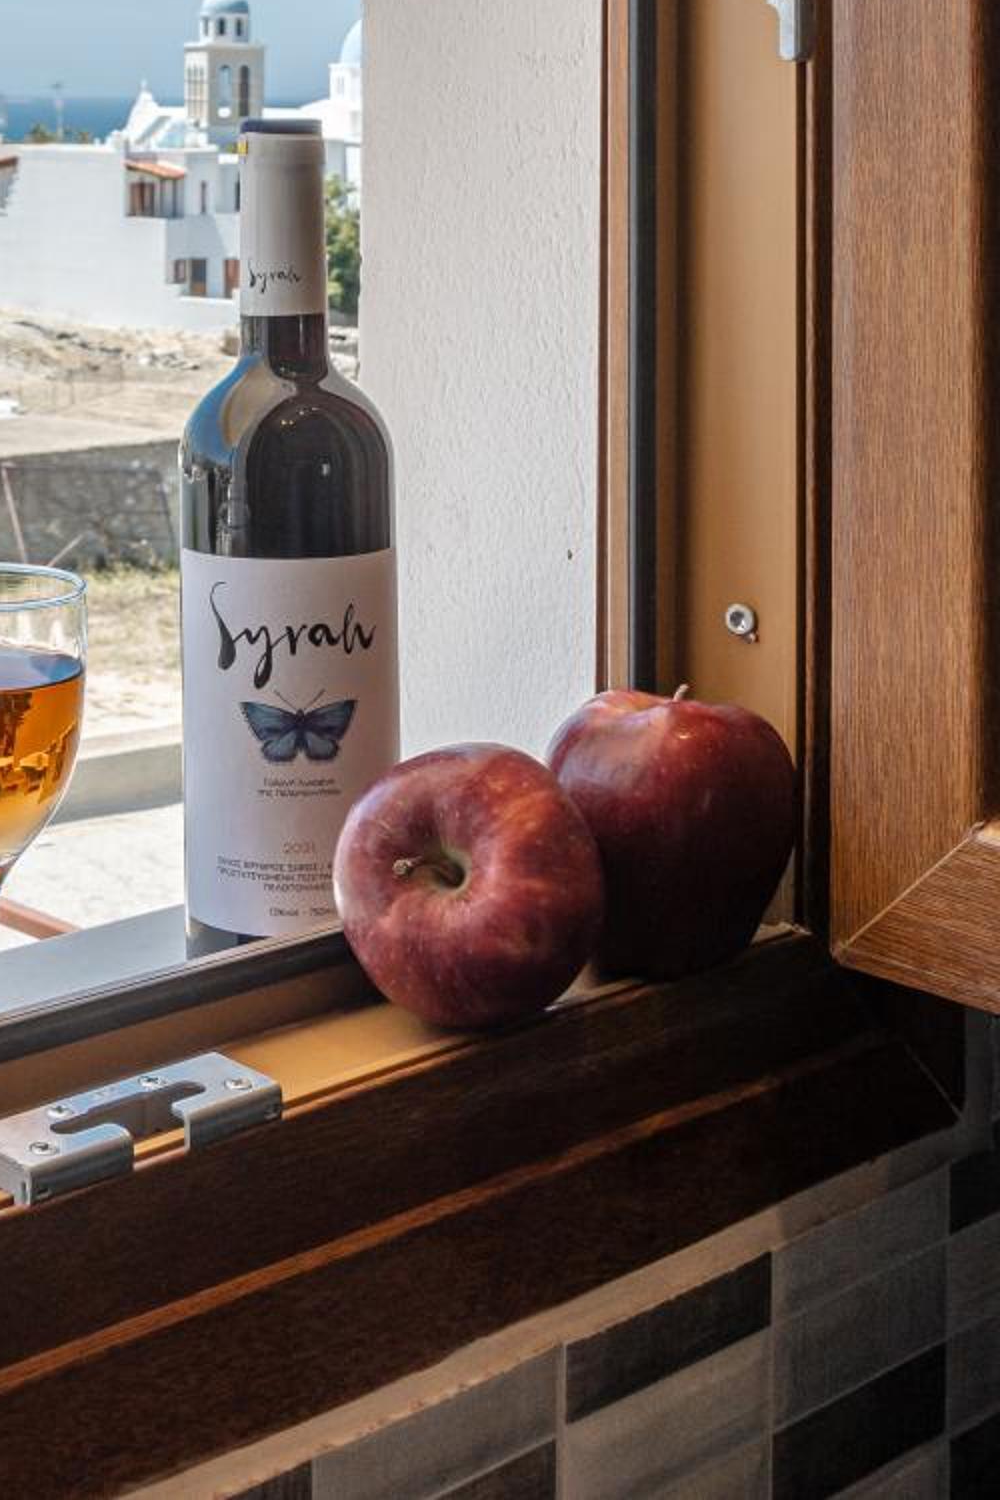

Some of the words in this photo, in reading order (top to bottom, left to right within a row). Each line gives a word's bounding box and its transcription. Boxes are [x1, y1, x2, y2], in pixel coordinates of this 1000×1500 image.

[248, 260, 302, 293] Syrah
[209, 580, 377, 688] Syrah
[283, 841, 315, 854] 2021
